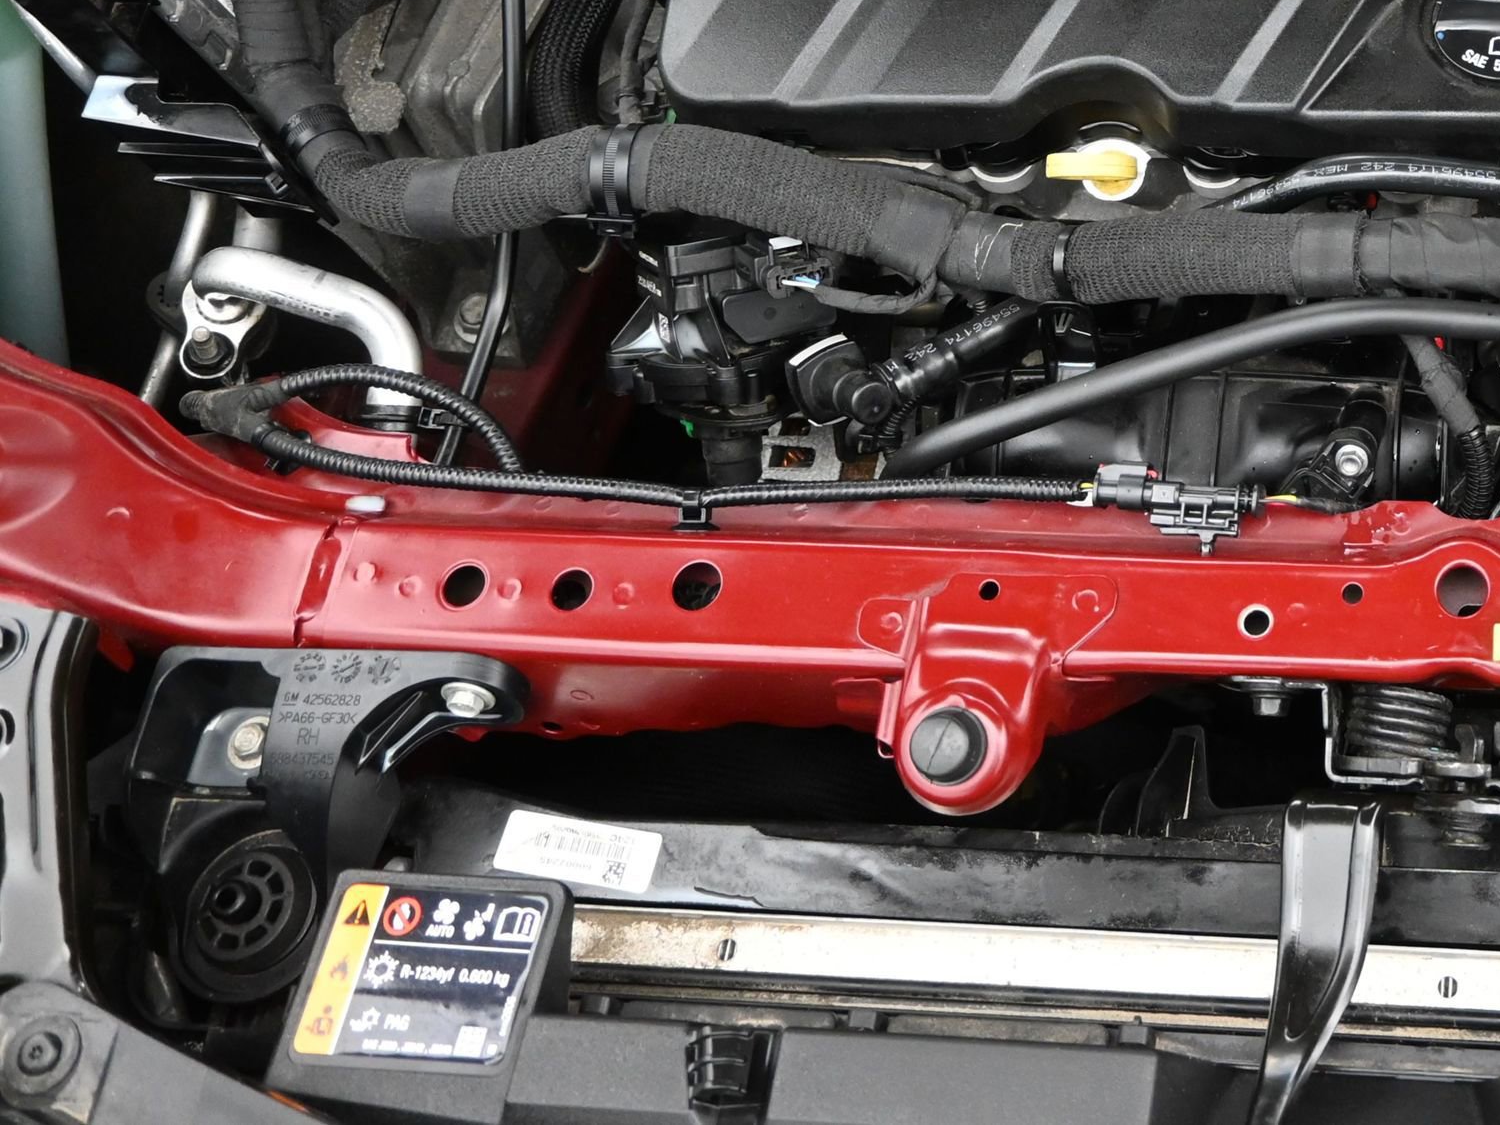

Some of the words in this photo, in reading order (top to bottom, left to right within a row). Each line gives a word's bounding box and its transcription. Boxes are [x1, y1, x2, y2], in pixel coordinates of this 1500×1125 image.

[1461, 49, 1489, 69] SAE
[1314, 164, 1348, 176] MEX
[1361, 162, 1396, 172] 242
[945, 303, 1021, 345] 55496174
[283, 692, 299, 703] GM
[302, 694, 361, 706] 42562828
[278, 712, 357, 724] >PA66-GF30<
[297, 727, 320, 746] RH
[425, 924, 455, 938] AUTO
